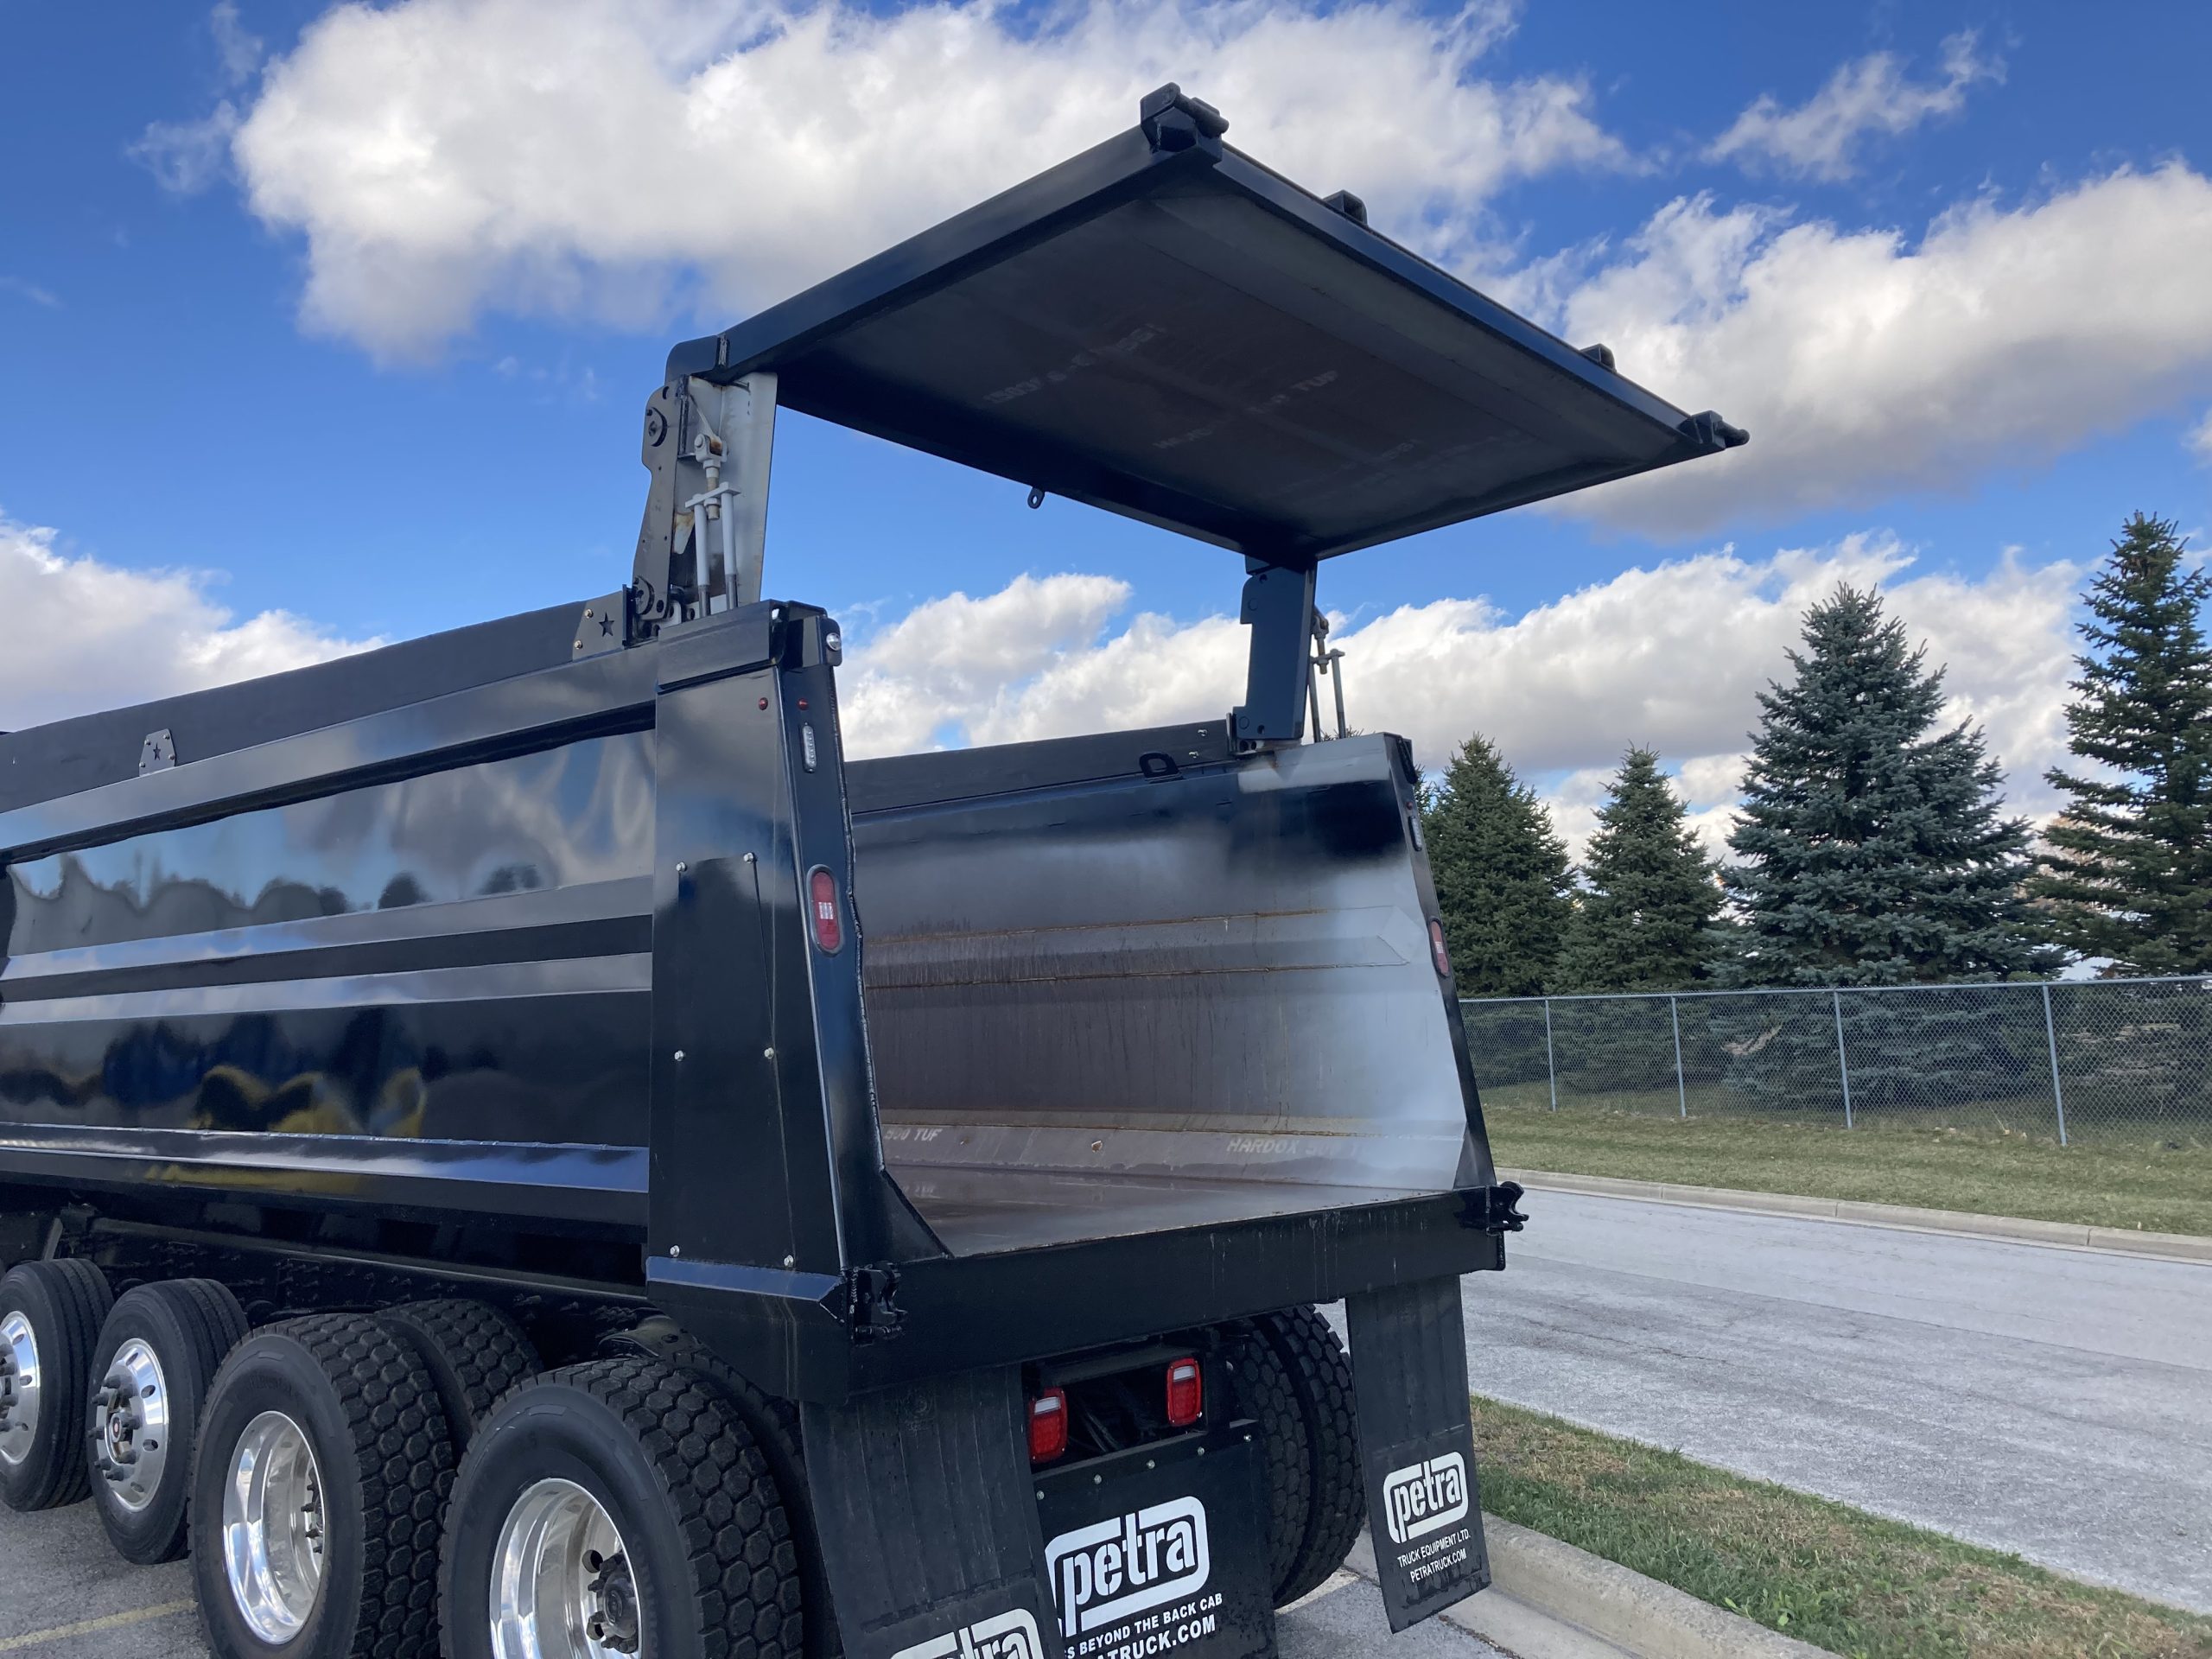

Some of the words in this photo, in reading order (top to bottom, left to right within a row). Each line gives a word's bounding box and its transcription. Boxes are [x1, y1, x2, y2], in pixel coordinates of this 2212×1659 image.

[914, 1128, 943, 1141] TUF
[1226, 1137, 1300, 1154] HARDOX
[1393, 1460, 1462, 1543] petra
[1397, 1548, 1421, 1567] TRUCK
[1421, 1533, 1457, 1558] EQUIPMENT
[1409, 1548, 1467, 1583] PETRATRUCK.COM
[1063, 1513, 1196, 1637] petra
[1079, 1625, 1131, 1656] BEYOND
[1134, 1615, 1160, 1634] THE
[1163, 1602, 1197, 1624] BACK
[1199, 1592, 1223, 1611] CAB
